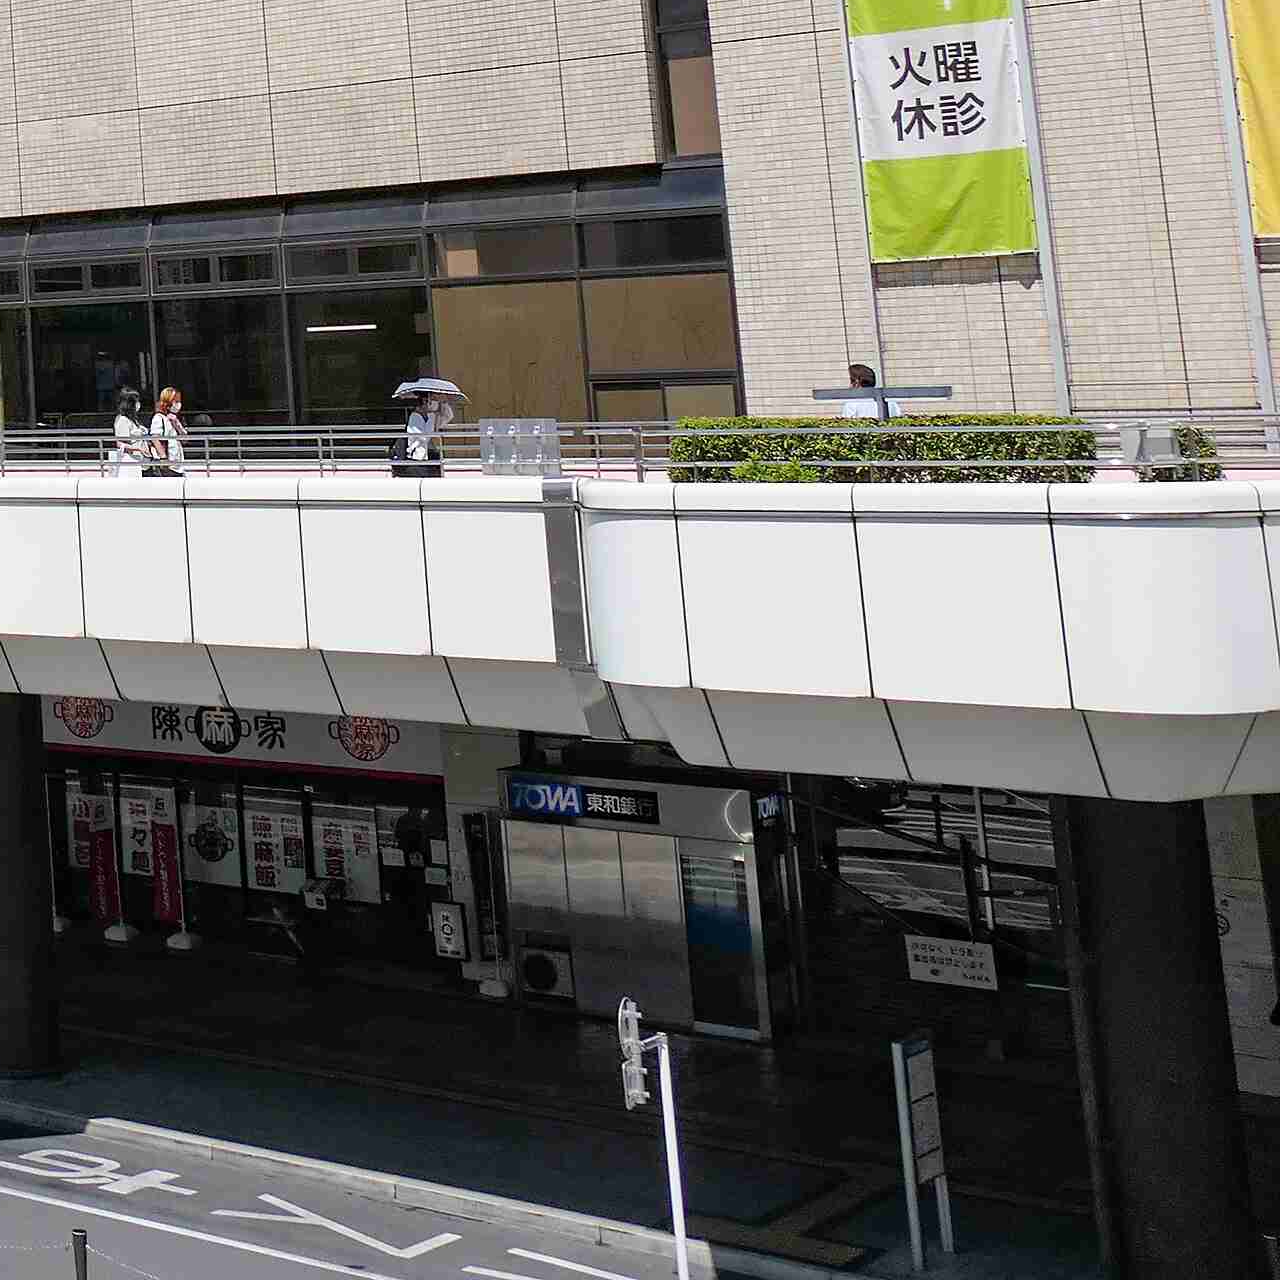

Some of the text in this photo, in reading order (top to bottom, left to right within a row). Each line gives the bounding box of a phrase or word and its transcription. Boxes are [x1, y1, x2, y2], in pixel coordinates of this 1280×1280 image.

[888, 42, 983, 90] 火曜
[891, 92, 987, 142] 休診
[513, 781, 582, 816] TOWA
